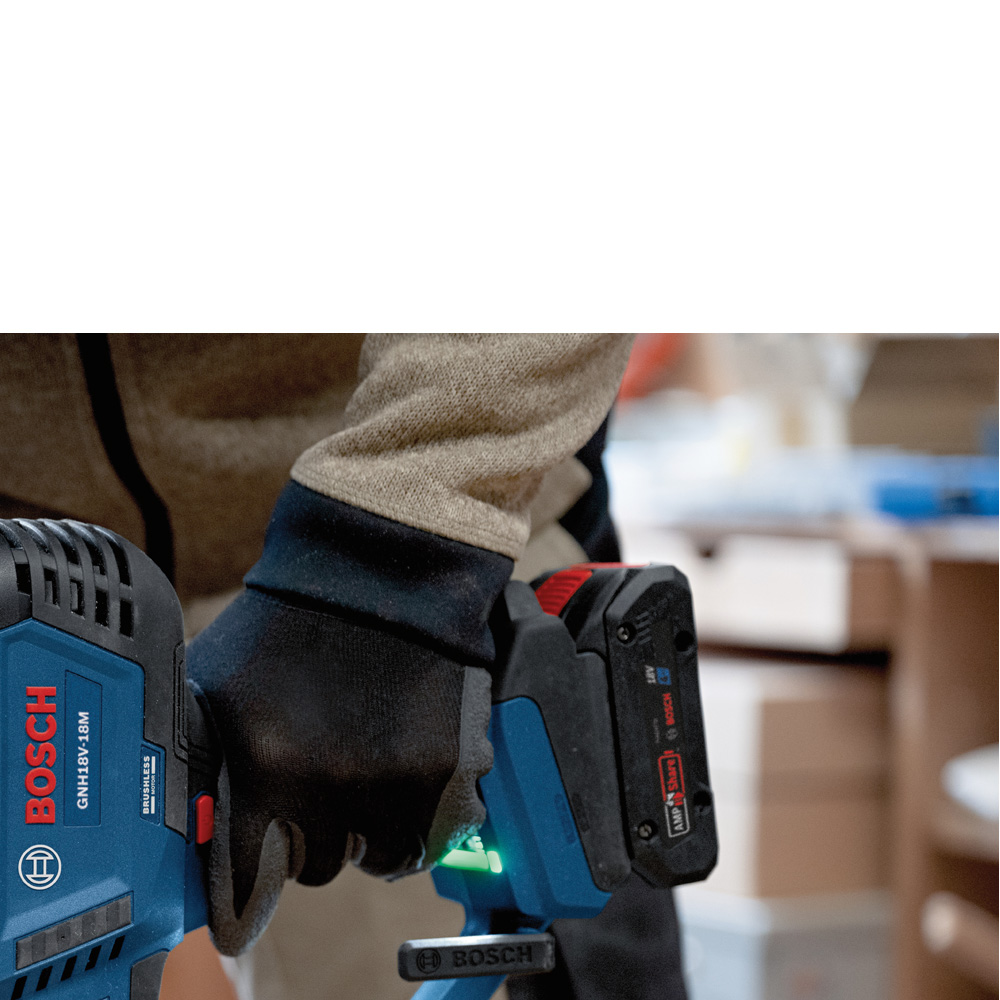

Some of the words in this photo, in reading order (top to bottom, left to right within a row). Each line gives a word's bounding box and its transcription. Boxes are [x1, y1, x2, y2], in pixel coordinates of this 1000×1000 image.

[661, 692, 675, 726] BOSCH
[24, 685, 57, 825] BOSCH
[76, 711, 90, 810] GNH18V-18M
[142, 755, 150, 815] BRUSHLESS
[665, 758, 679, 792] Share
[672, 806, 685, 832] AMP
[451, 945, 532, 968] BOSCH
